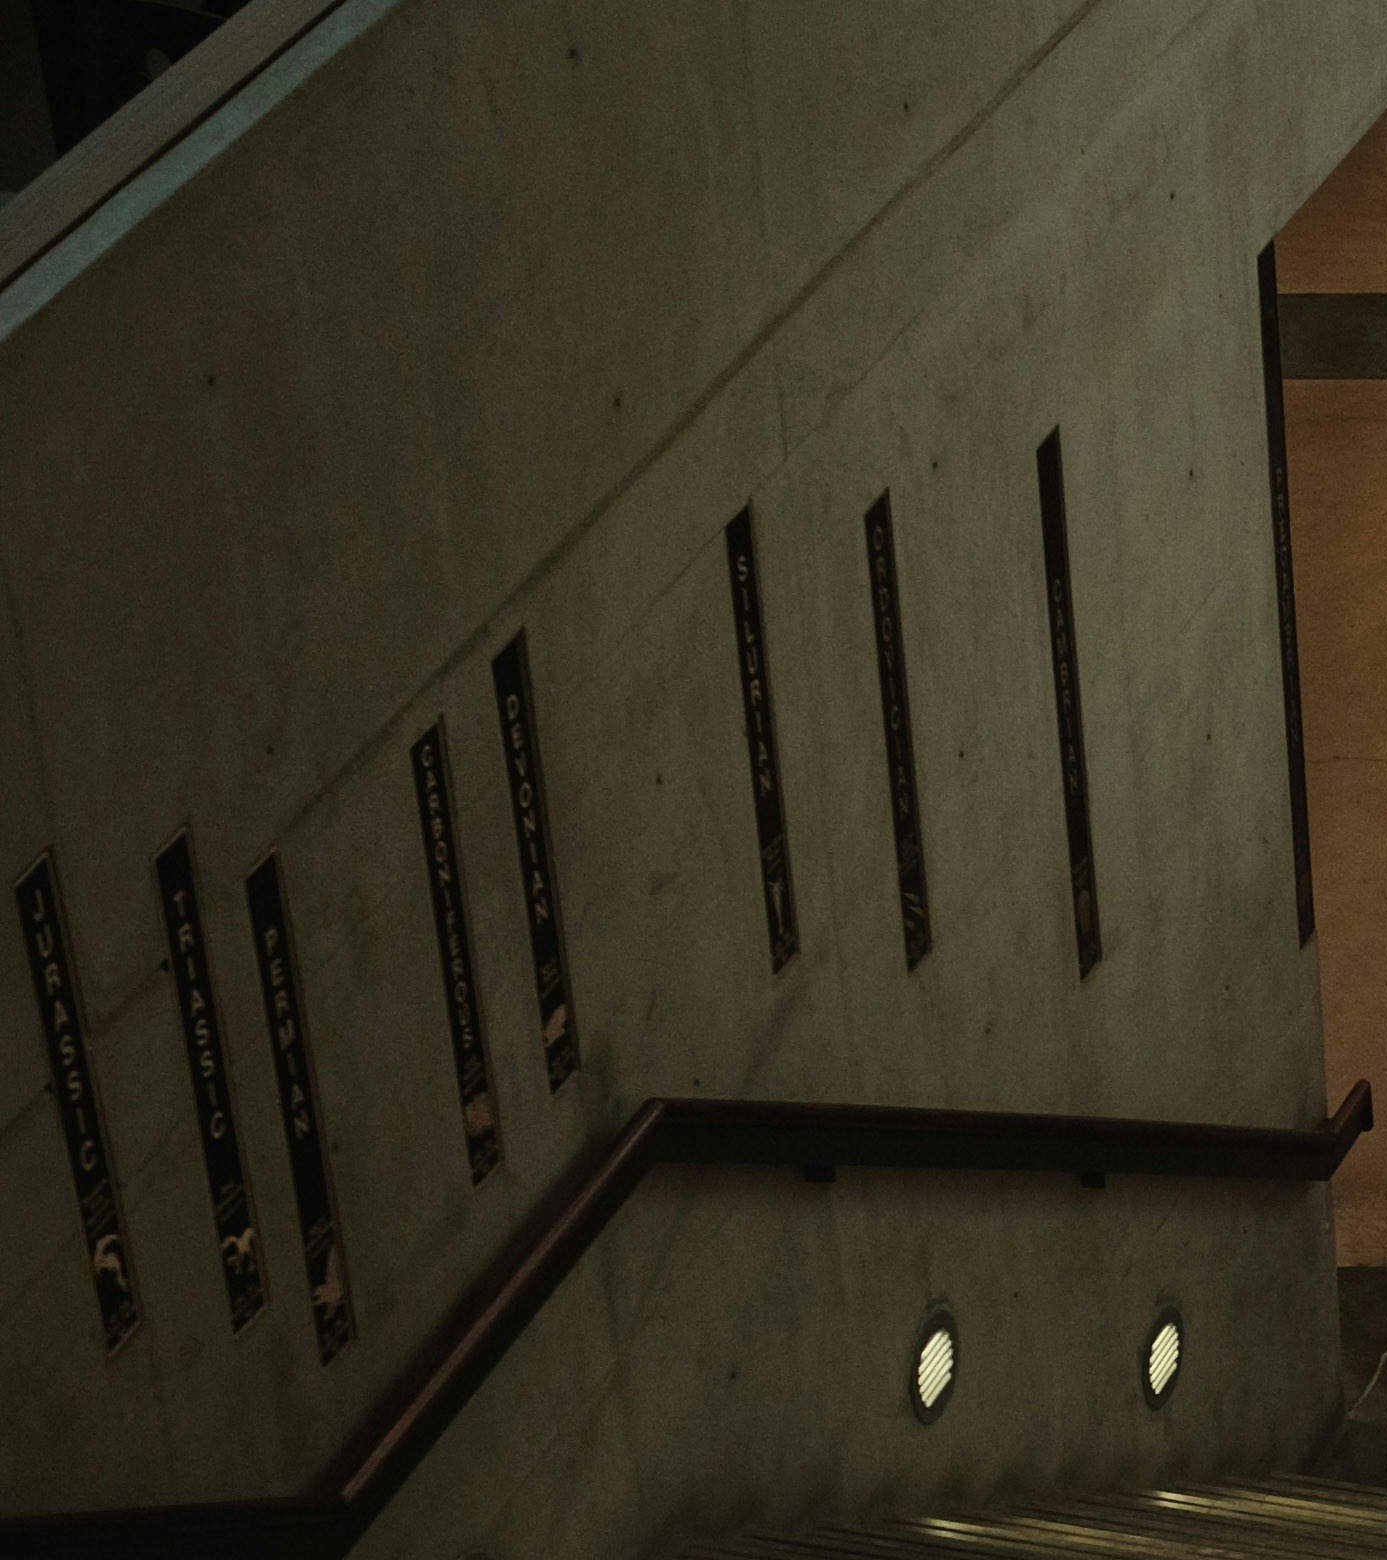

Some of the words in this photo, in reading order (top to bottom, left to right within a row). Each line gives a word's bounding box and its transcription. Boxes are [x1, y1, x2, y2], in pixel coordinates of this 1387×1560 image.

[736, 554, 772, 799] SILURIAN
[872, 524, 909, 816] ORDOVICIAN
[1052, 577, 1079, 793] CAMBRIAN
[420, 743, 474, 1050] CARBONIFEROUS
[505, 692, 549, 925] DEVONIAN
[30, 887, 97, 1172] JURASSIC
[171, 887, 228, 1141] TRIASSIC
[263, 927, 310, 1142] PERMIAN
